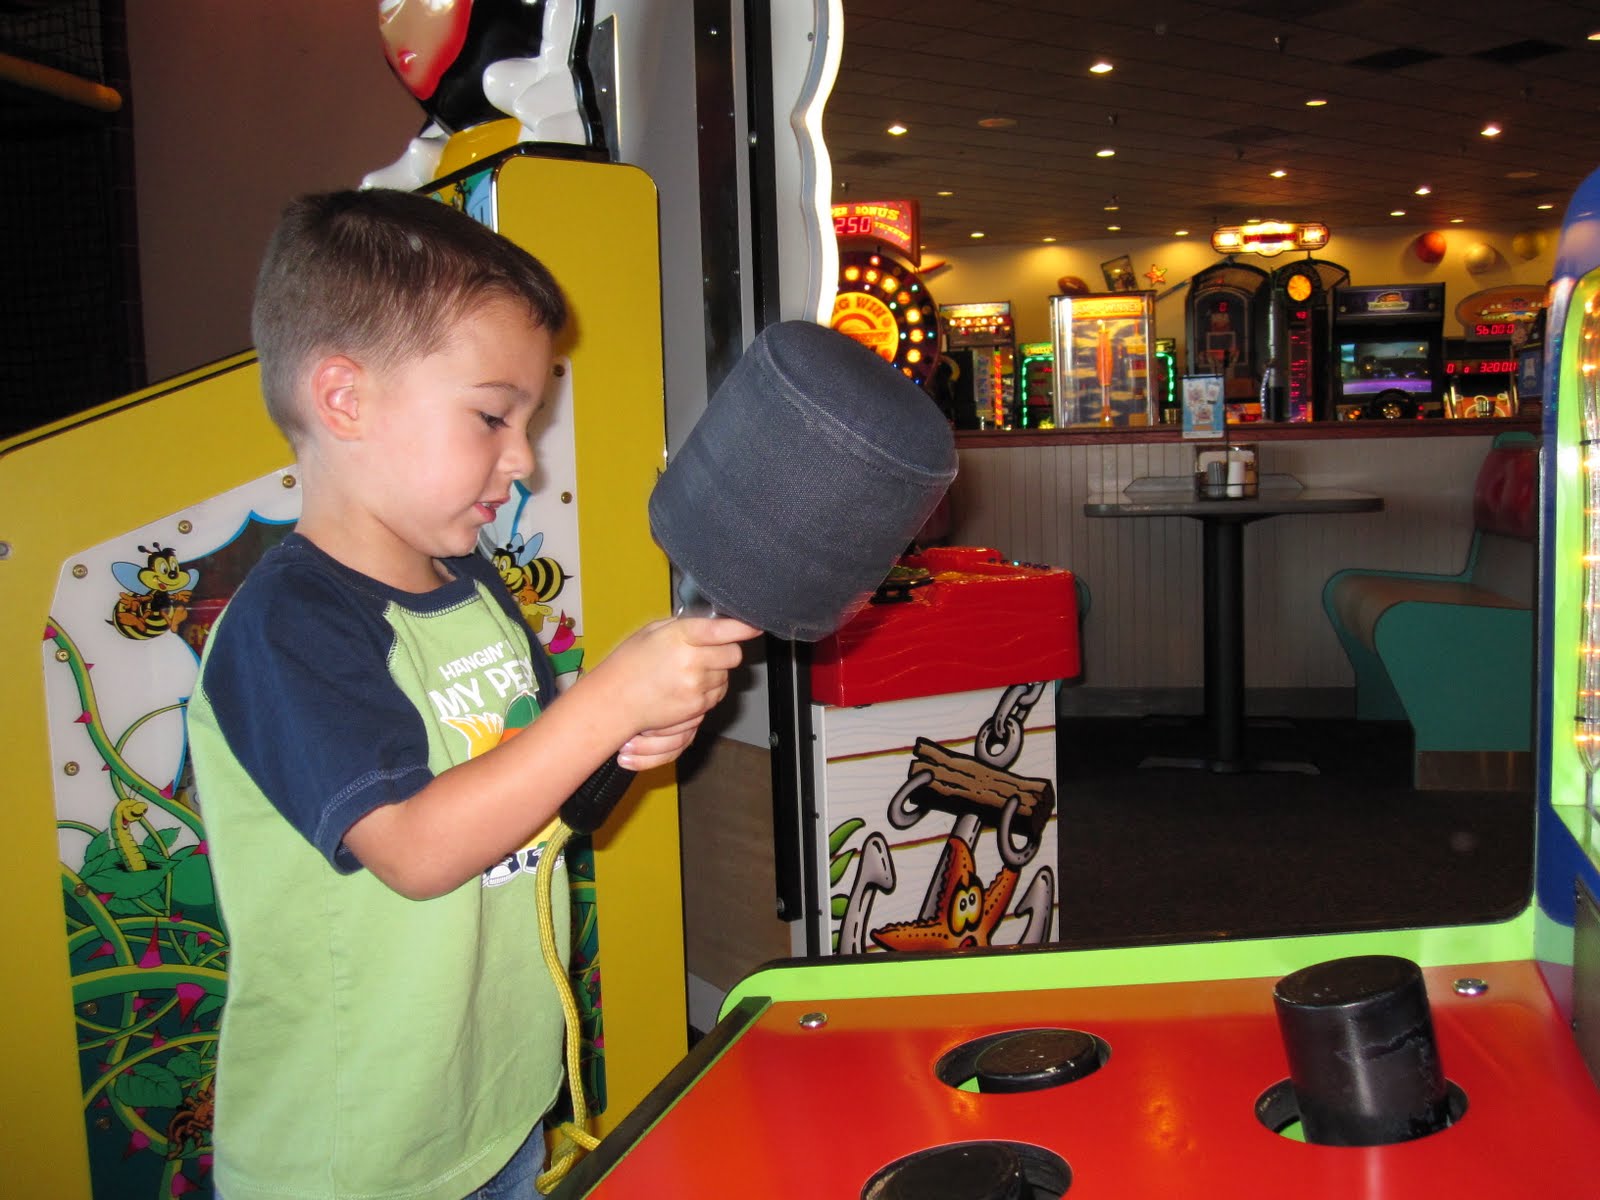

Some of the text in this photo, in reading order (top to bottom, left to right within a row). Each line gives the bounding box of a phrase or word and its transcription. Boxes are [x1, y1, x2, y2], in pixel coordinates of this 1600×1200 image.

[855, 205, 900, 221] BONUS
[835, 216, 871, 234] 250
[856, 296, 887, 319] WIN
[438, 641, 505, 681] HANGIN'
[428, 677, 485, 718] MY
